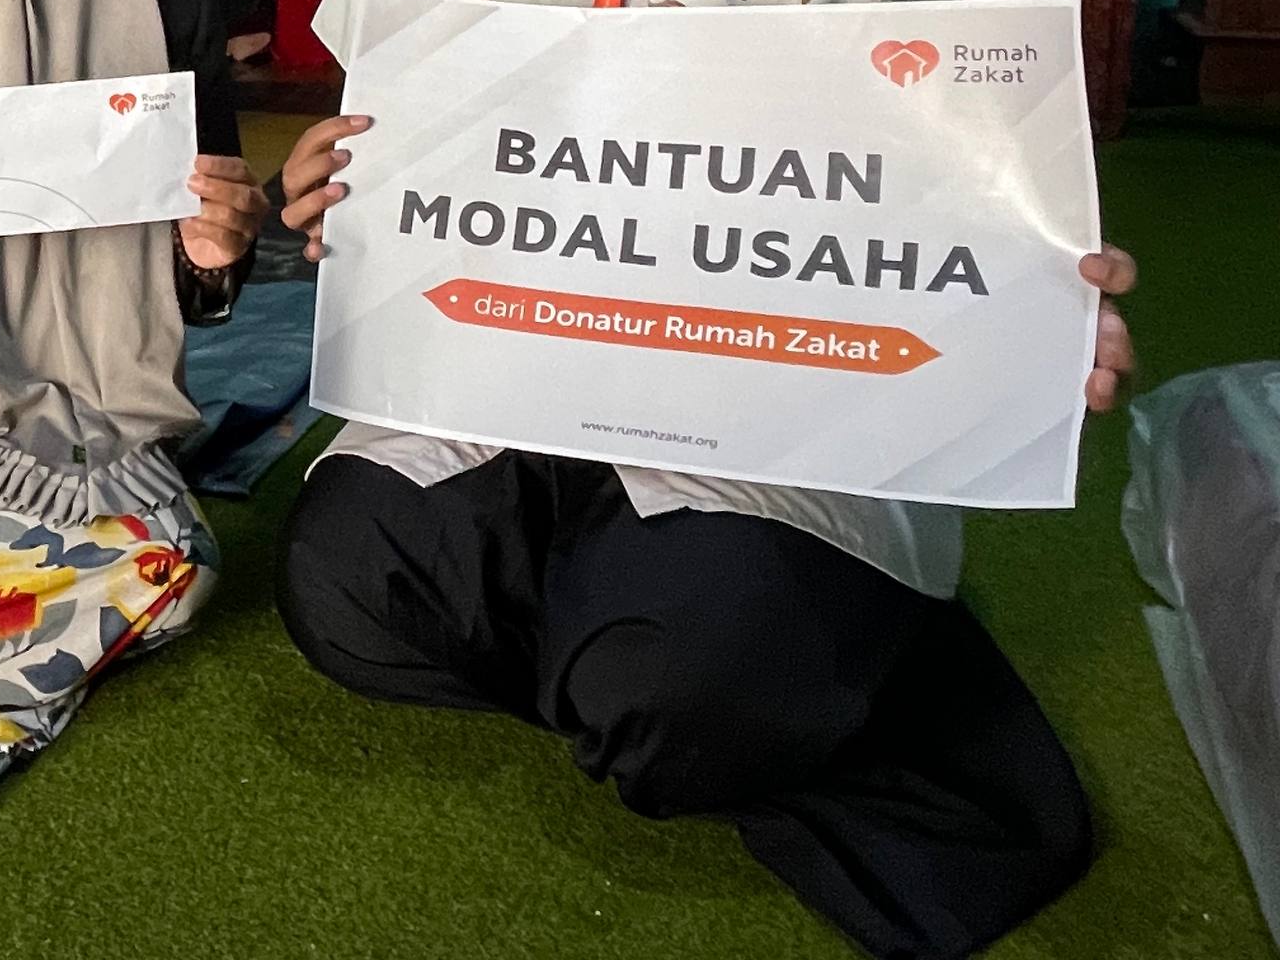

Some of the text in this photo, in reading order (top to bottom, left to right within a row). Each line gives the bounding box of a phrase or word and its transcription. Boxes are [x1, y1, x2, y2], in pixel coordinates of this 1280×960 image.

[953, 44, 1038, 62] Rumah
[953, 66, 1025, 83] Zakat
[141, 92, 176, 102] Rumah
[142, 102, 170, 112] Zakat
[495, 128, 882, 203] BANTUAN
[399, 190, 990, 296] MODAL USAHA
[474, 294, 881, 362] dari Donatur Rumah Zakat
[581, 421, 718, 449] www.rumahzakat.org
